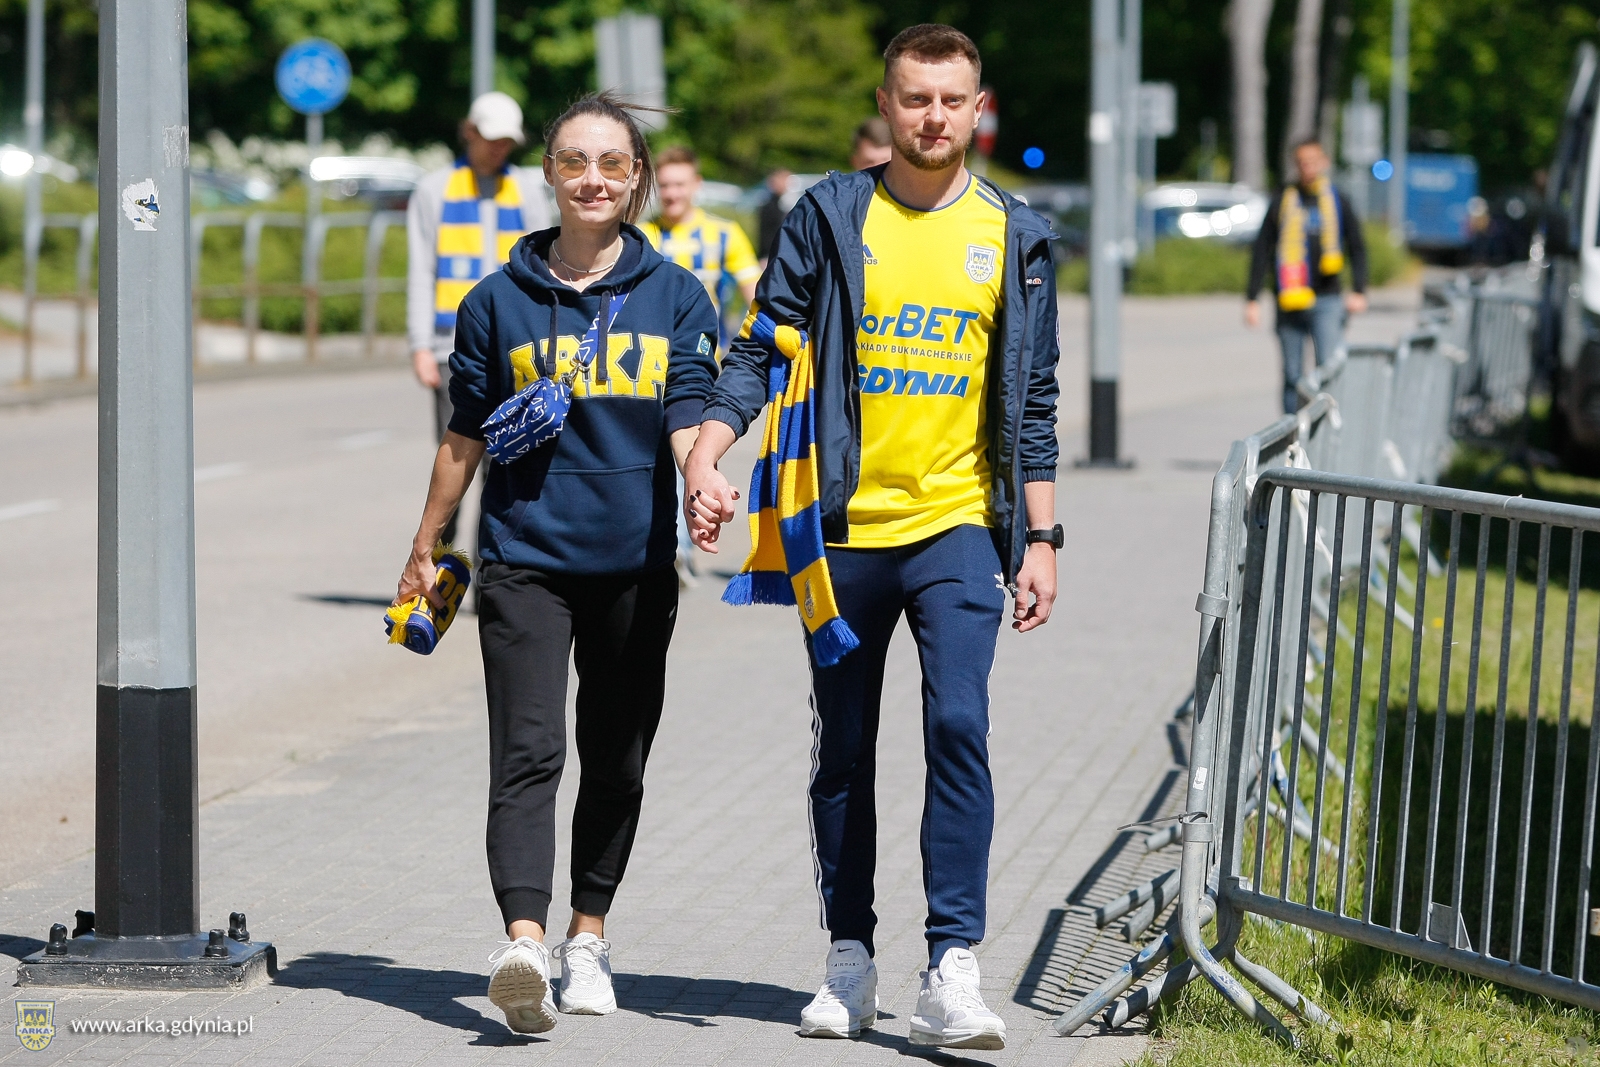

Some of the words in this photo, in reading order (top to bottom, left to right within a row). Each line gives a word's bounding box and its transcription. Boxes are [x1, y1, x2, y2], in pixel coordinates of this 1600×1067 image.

[970, 264, 990, 272] ARKA
[860, 303, 980, 344] orBET
[890, 344, 973, 362] BUKMACHERSKIE
